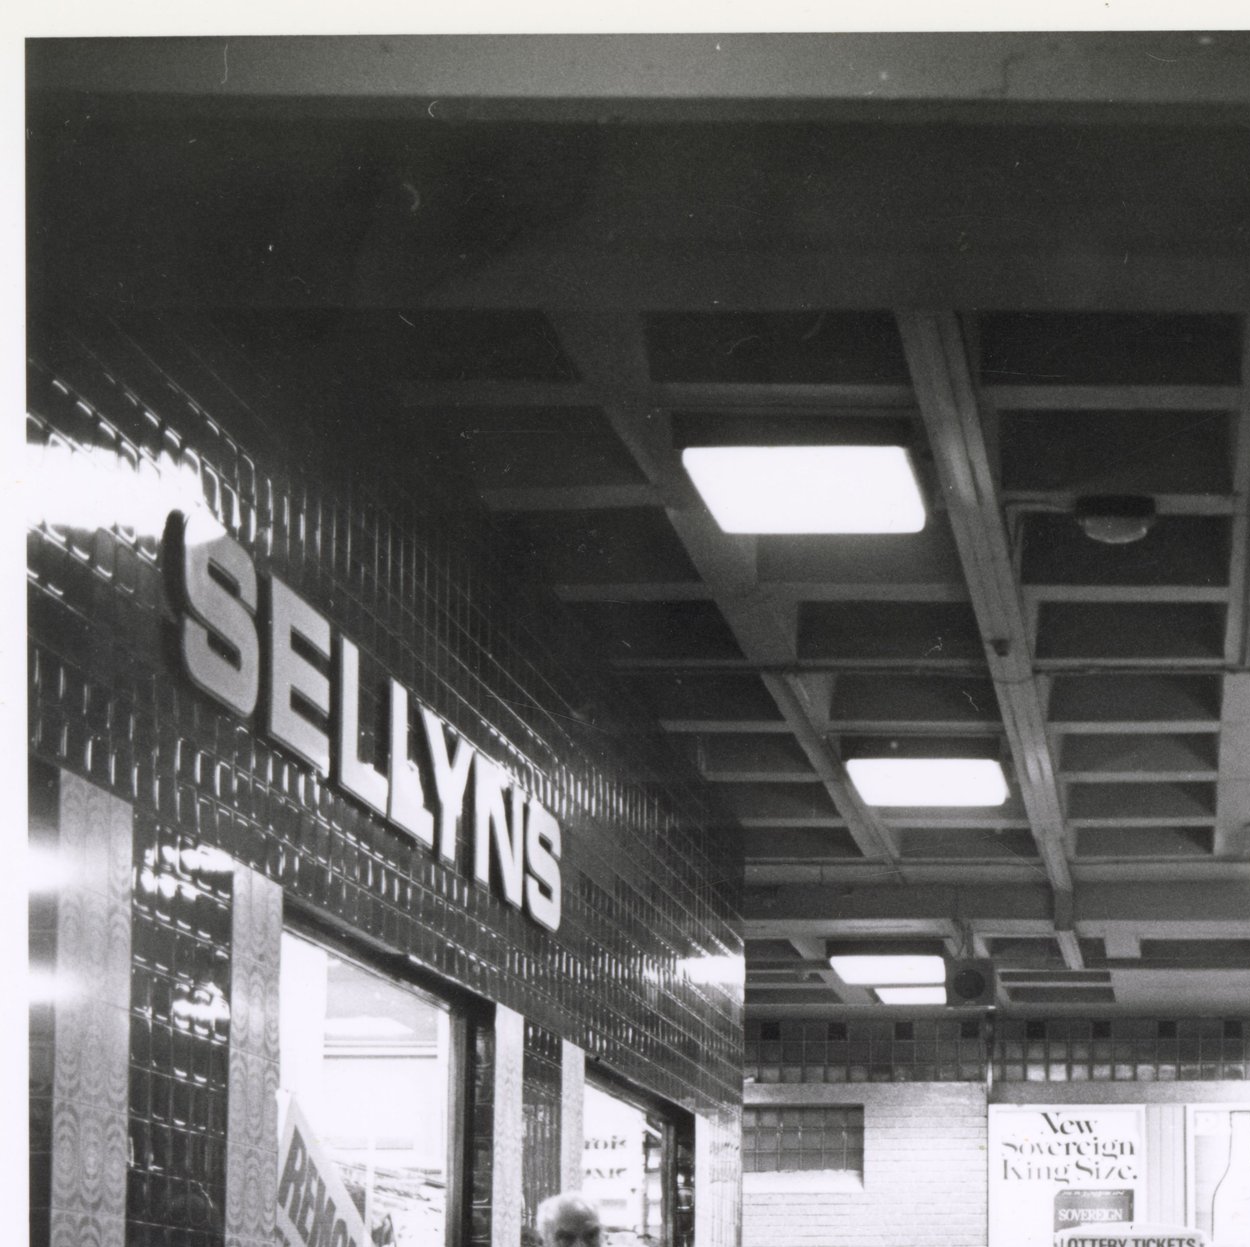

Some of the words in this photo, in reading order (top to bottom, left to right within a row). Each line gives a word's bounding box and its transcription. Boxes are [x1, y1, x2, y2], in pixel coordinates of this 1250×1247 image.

[164, 512, 562, 932] SELLYNS
[1041, 1112, 1097, 1135] New
[1002, 1136, 1134, 1159] Sovereign
[1003, 1159, 1069, 1183] King
[1058, 1208, 1123, 1222] SOVEREIGN
